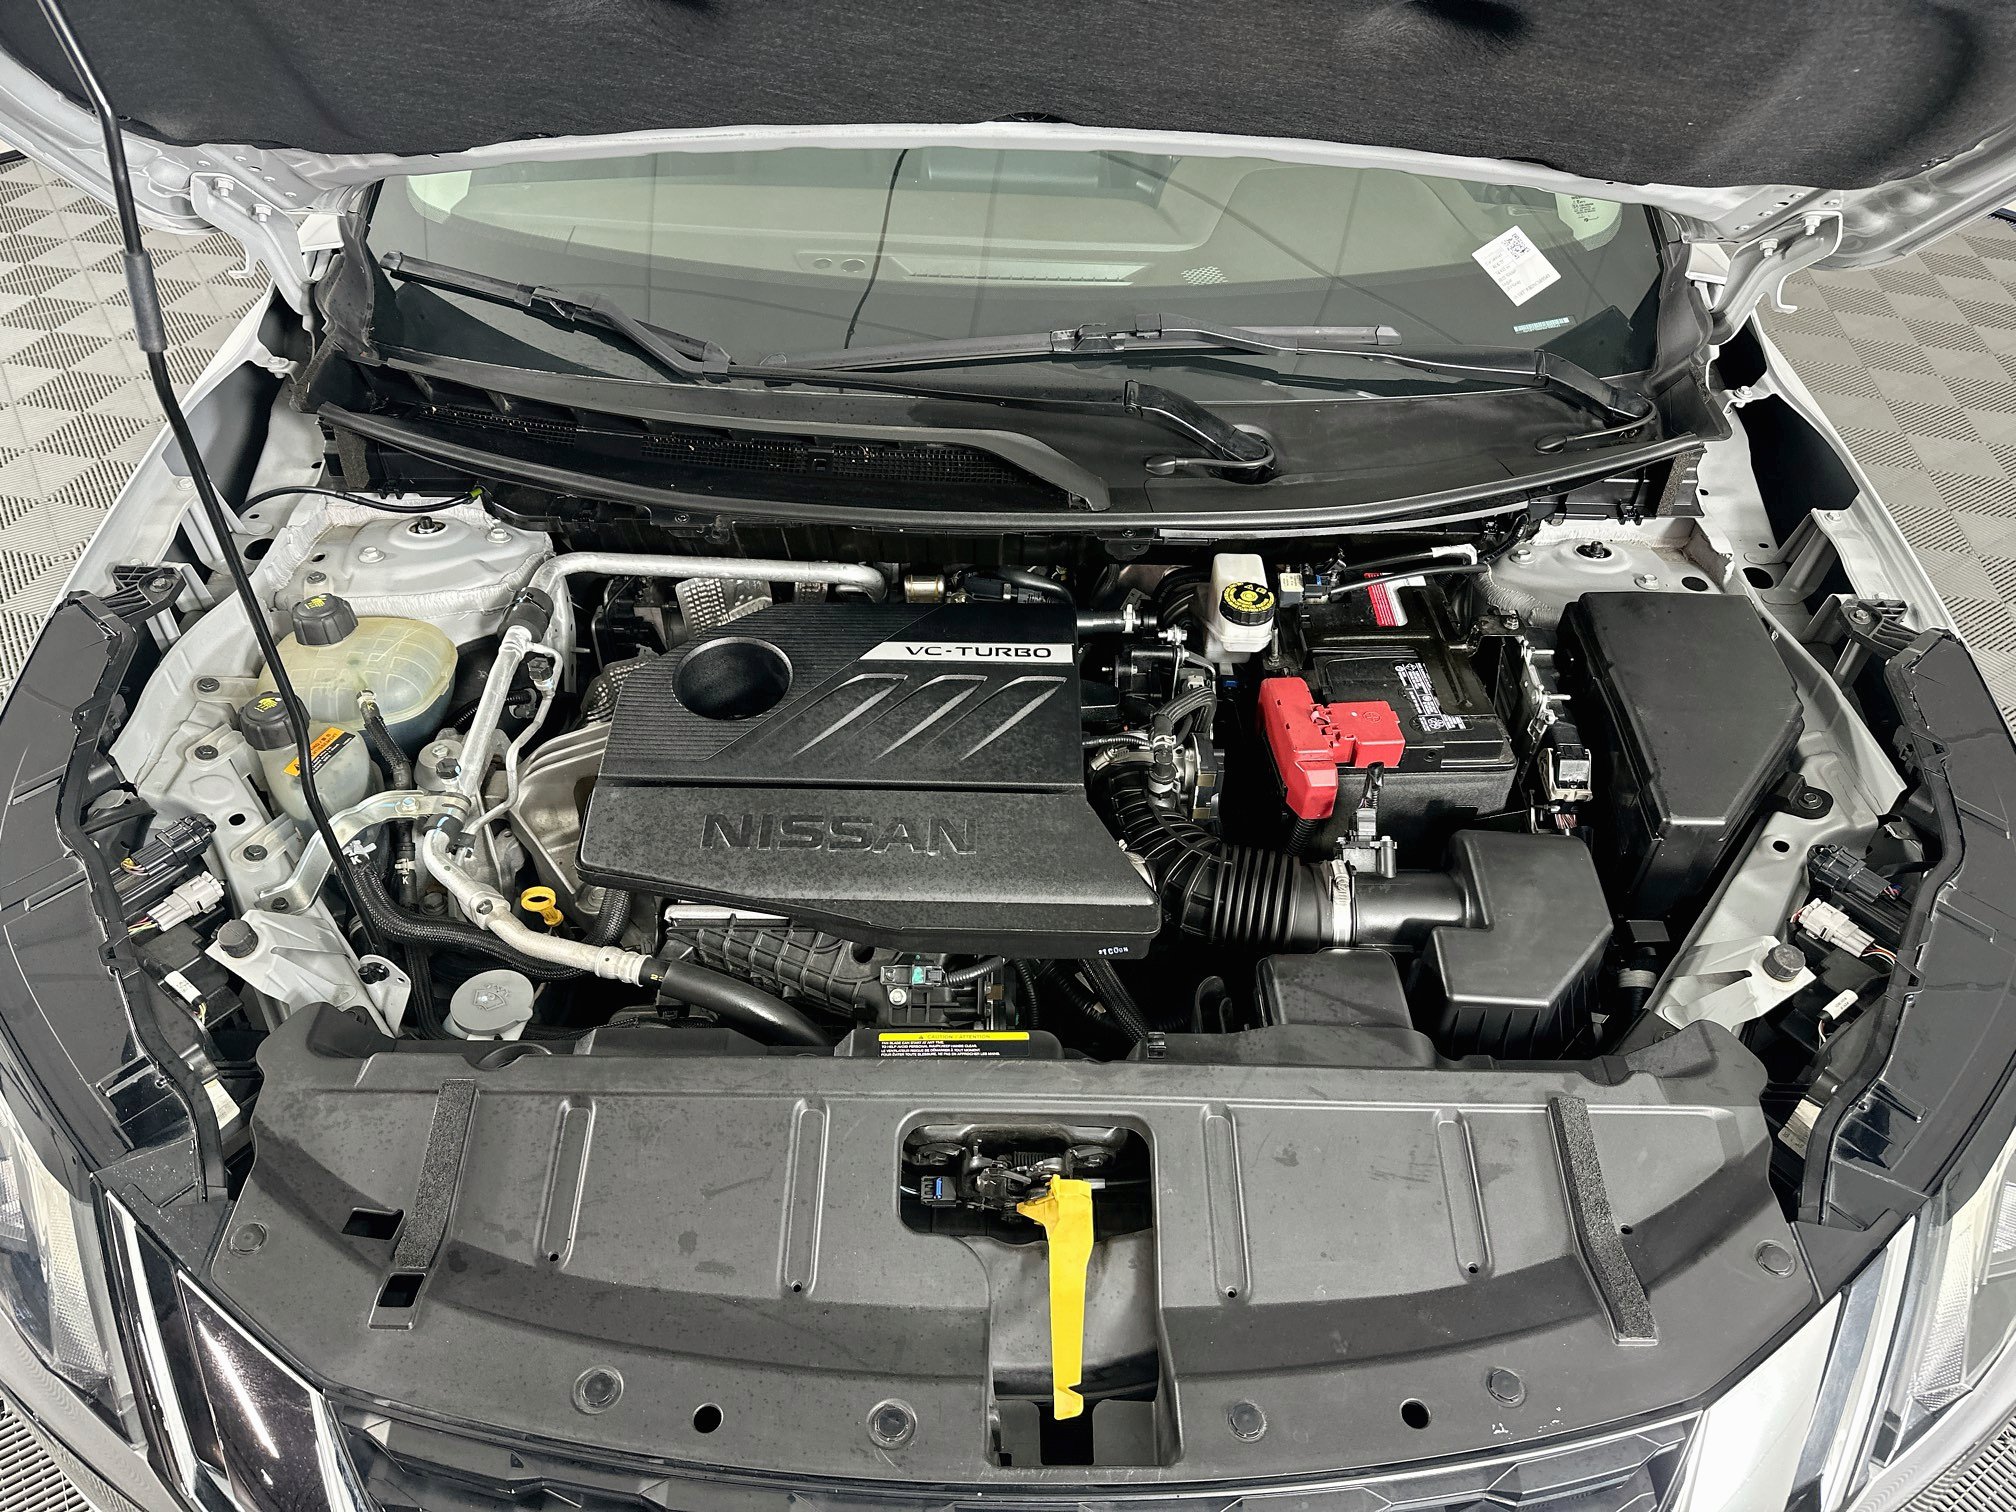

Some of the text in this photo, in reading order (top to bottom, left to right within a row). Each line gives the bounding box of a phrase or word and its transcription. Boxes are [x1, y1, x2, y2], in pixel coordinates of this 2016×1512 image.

[905, 646, 1052, 658] VC-TURBO
[700, 813, 977, 856] NISSAN
[351, 855, 362, 865] K
[402, 876, 409, 885] K
